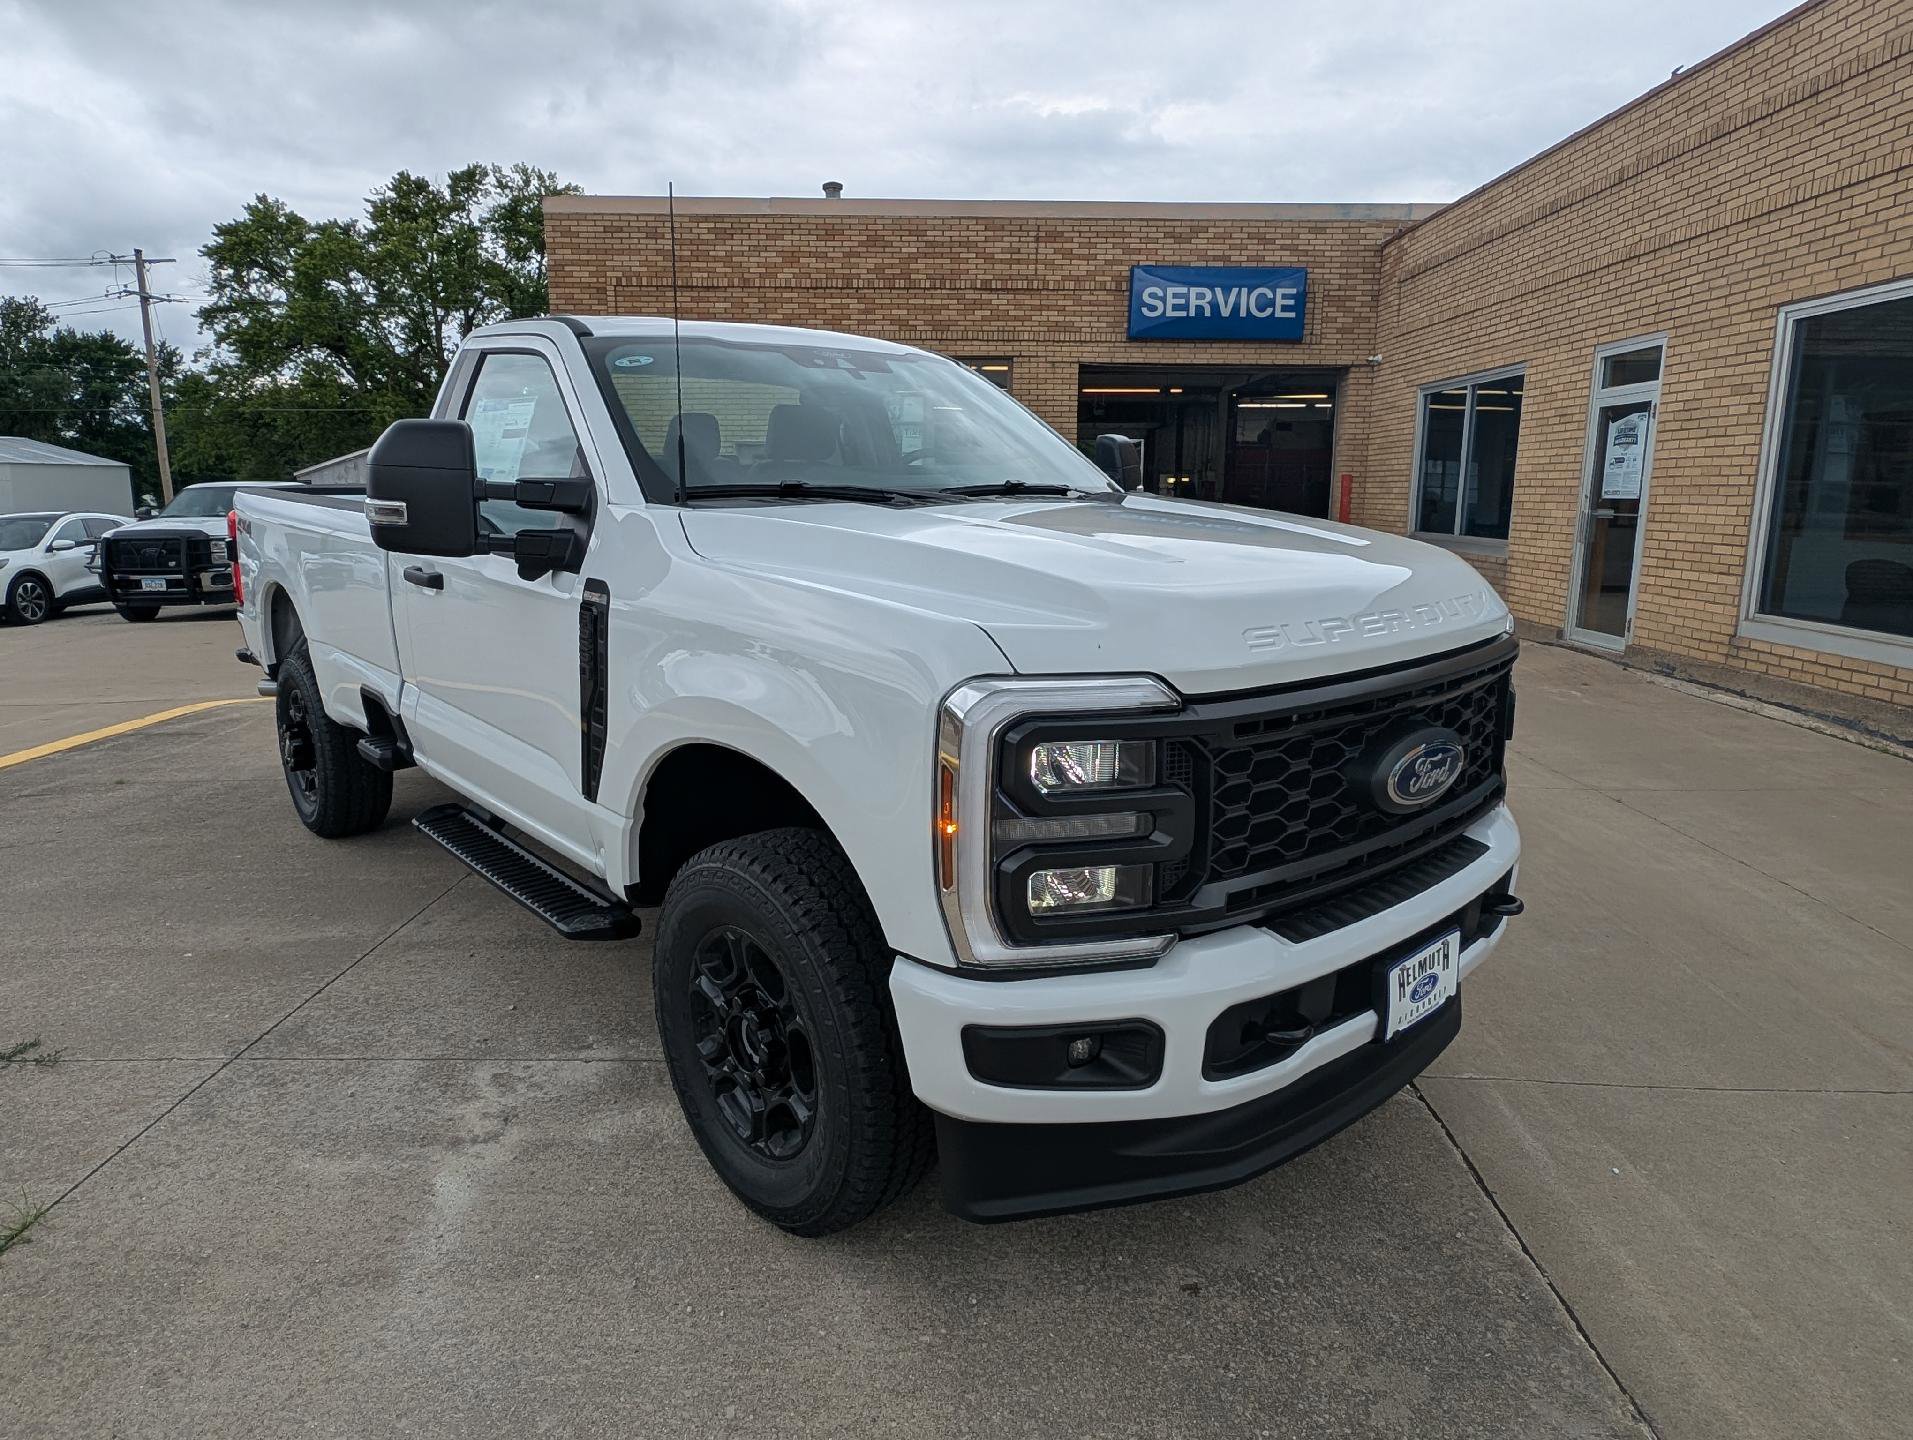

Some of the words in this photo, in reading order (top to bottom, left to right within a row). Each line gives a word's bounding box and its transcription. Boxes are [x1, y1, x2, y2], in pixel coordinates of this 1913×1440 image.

[1141, 287, 1297, 318] SERVICE
[1241, 608, 1415, 652] SUPER
[1397, 939, 1449, 1003] HELMUTH
